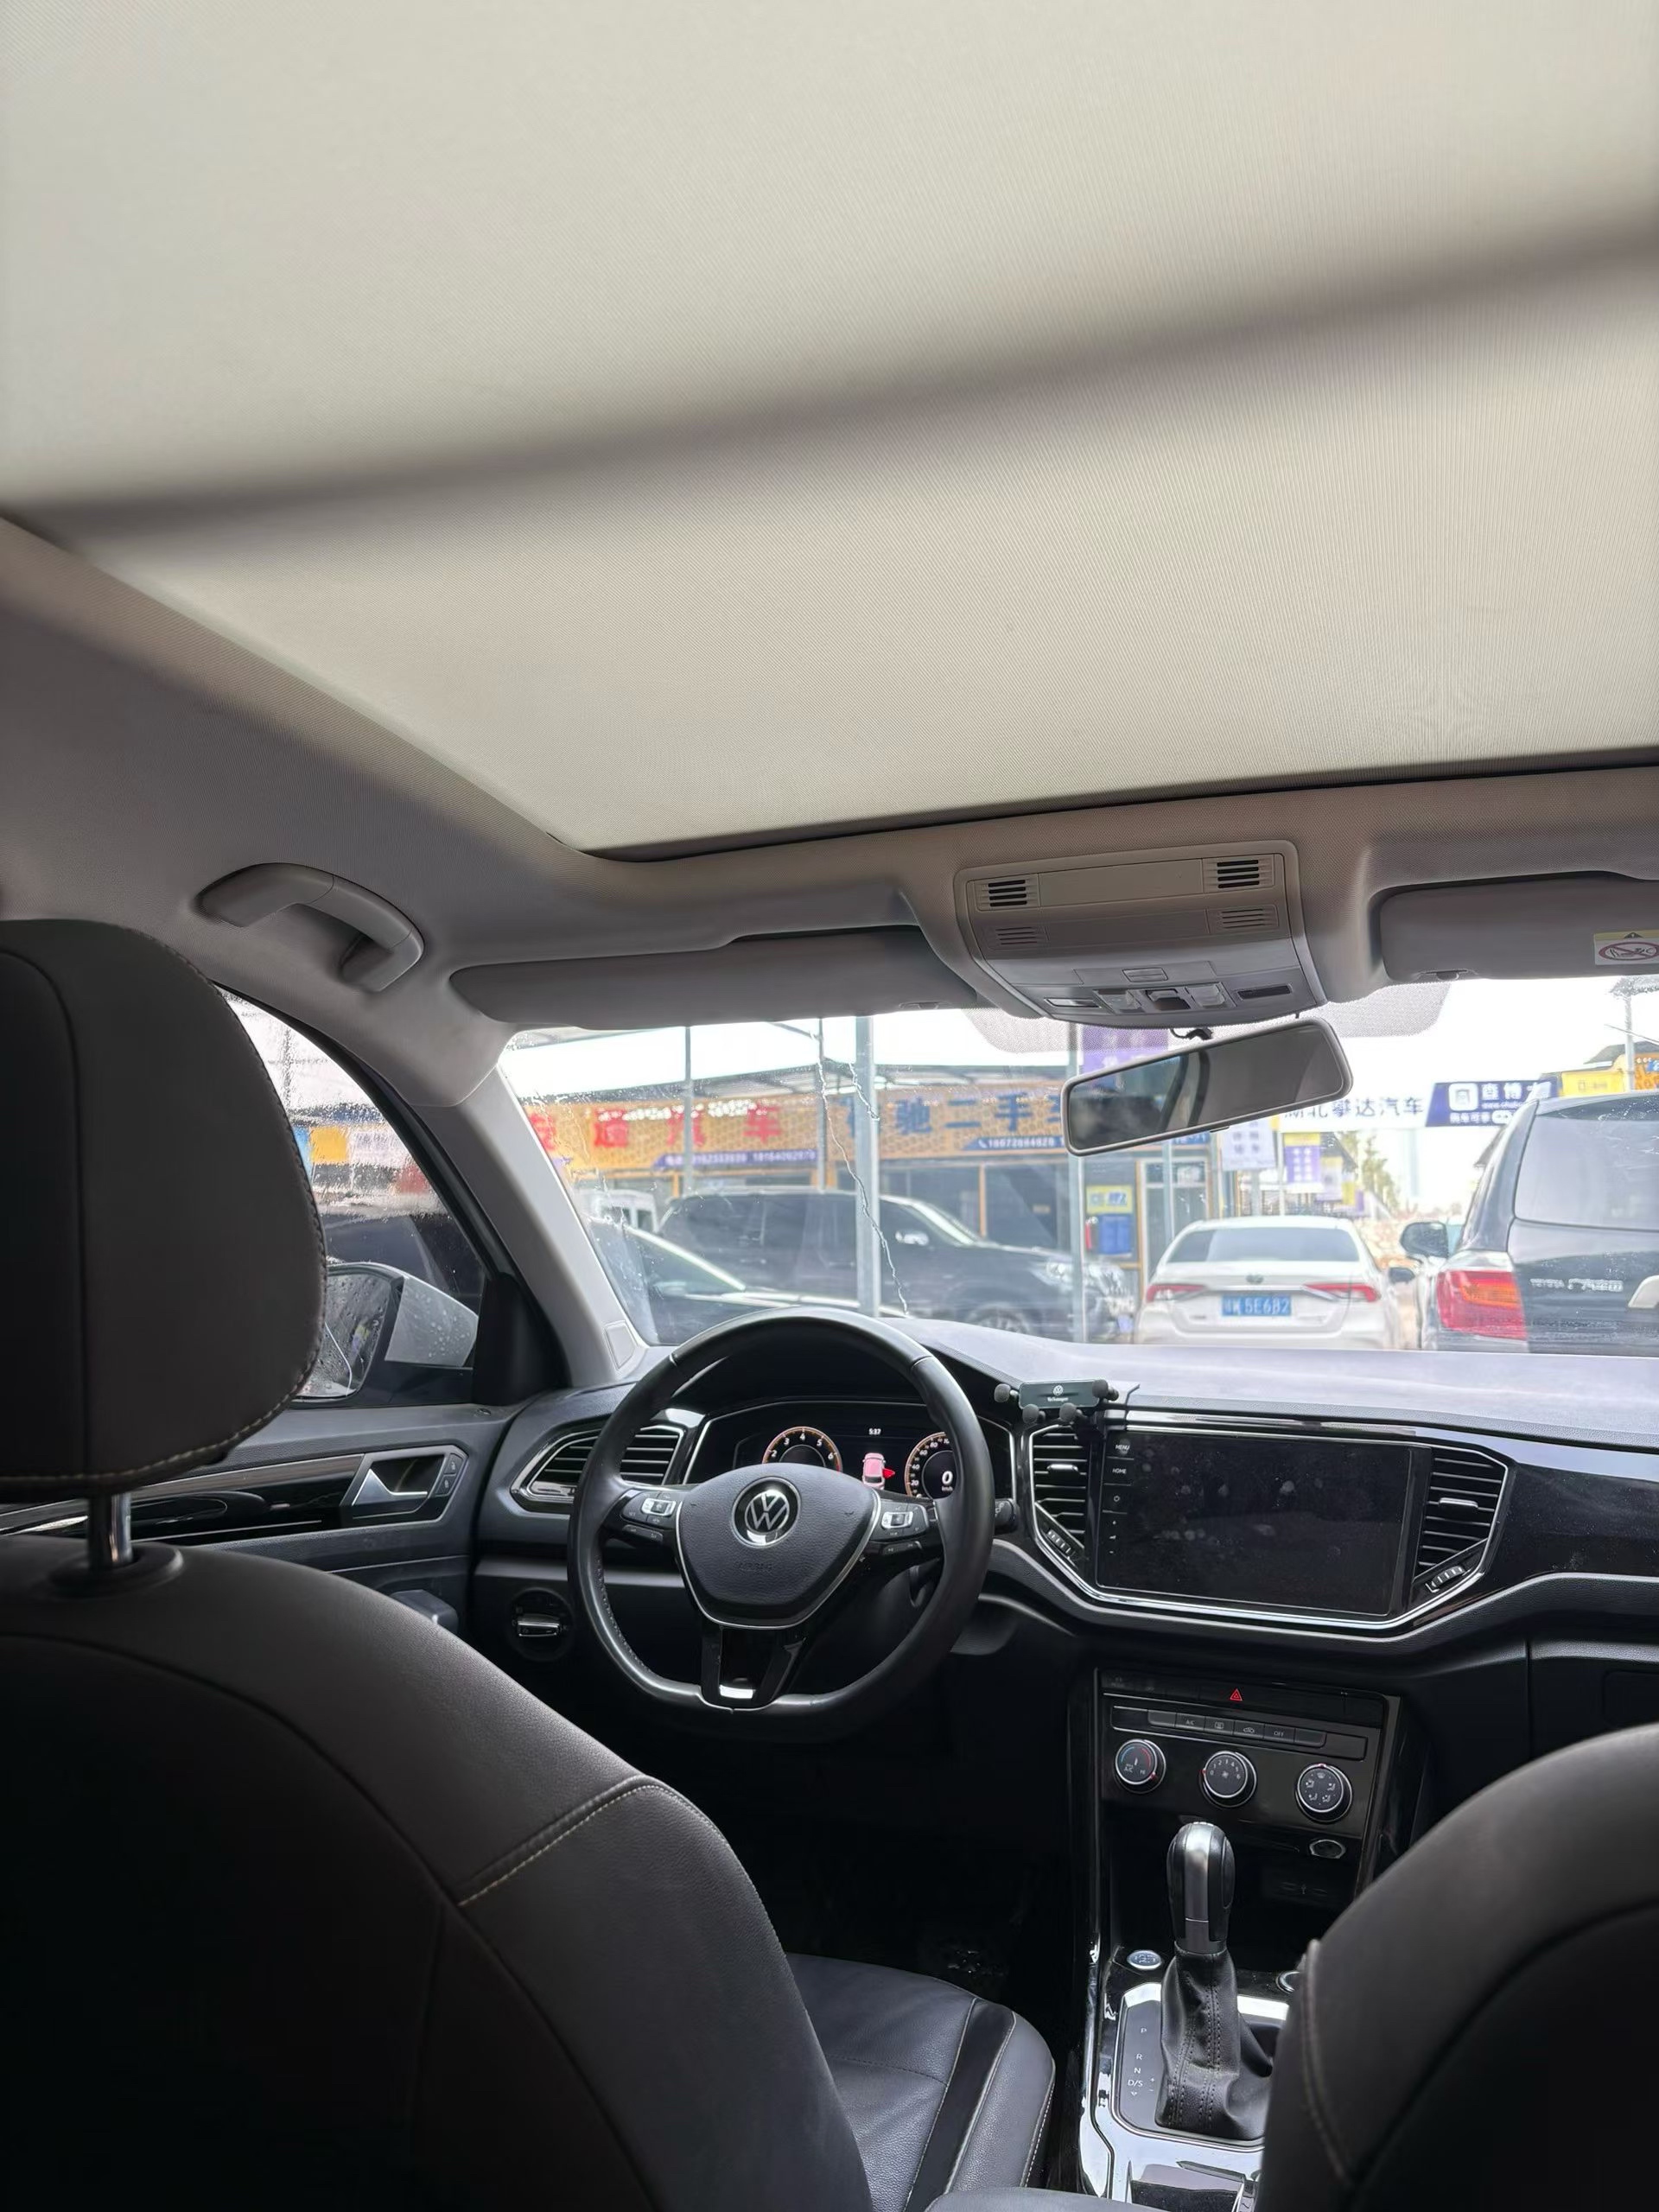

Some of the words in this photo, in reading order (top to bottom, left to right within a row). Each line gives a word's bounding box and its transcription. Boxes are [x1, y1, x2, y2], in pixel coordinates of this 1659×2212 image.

[784, 1437, 790, 1446] 3
[771, 1449, 778, 1458] 2
[827, 1452, 834, 1460] 6
[942, 1471, 953, 1485] 0
[1128, 2079, 1144, 2088] D/S
